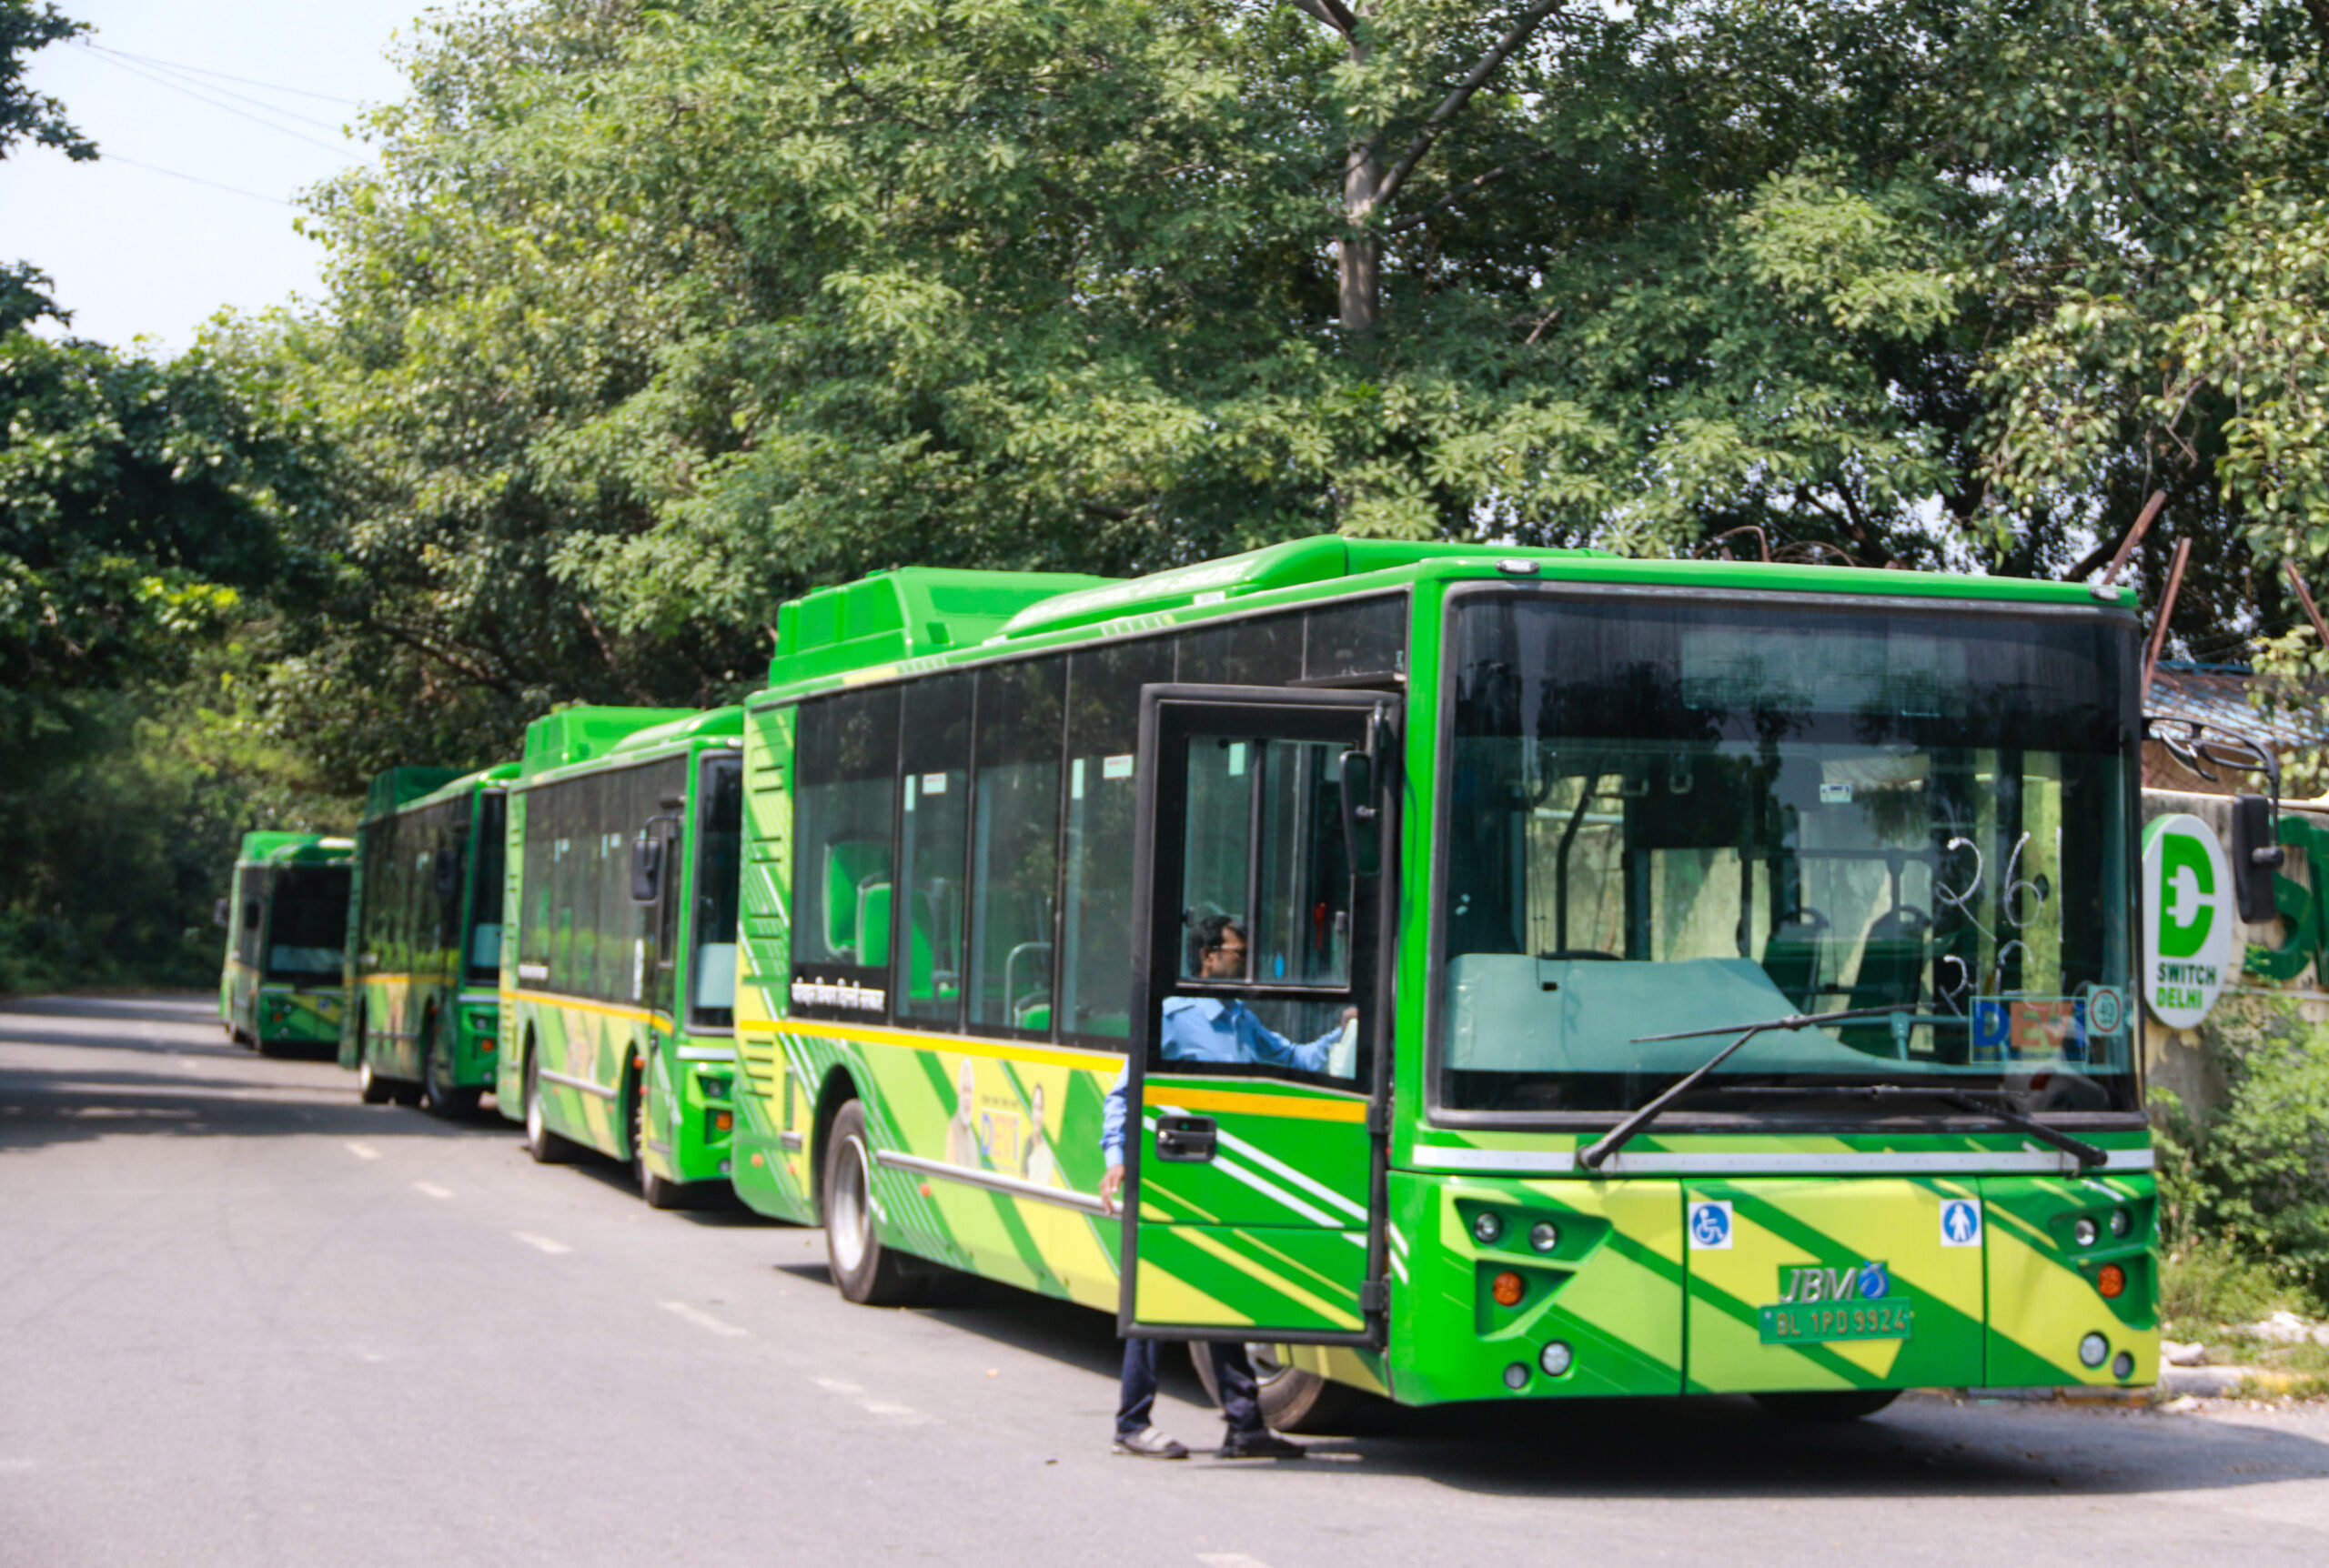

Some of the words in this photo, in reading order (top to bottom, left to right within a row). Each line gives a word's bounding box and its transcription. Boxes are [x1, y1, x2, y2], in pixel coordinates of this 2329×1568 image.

[2157, 961, 2217, 986] SWITCH
[2156, 987, 2203, 1010] DELHI
[1779, 1267, 1857, 1303] JBM
